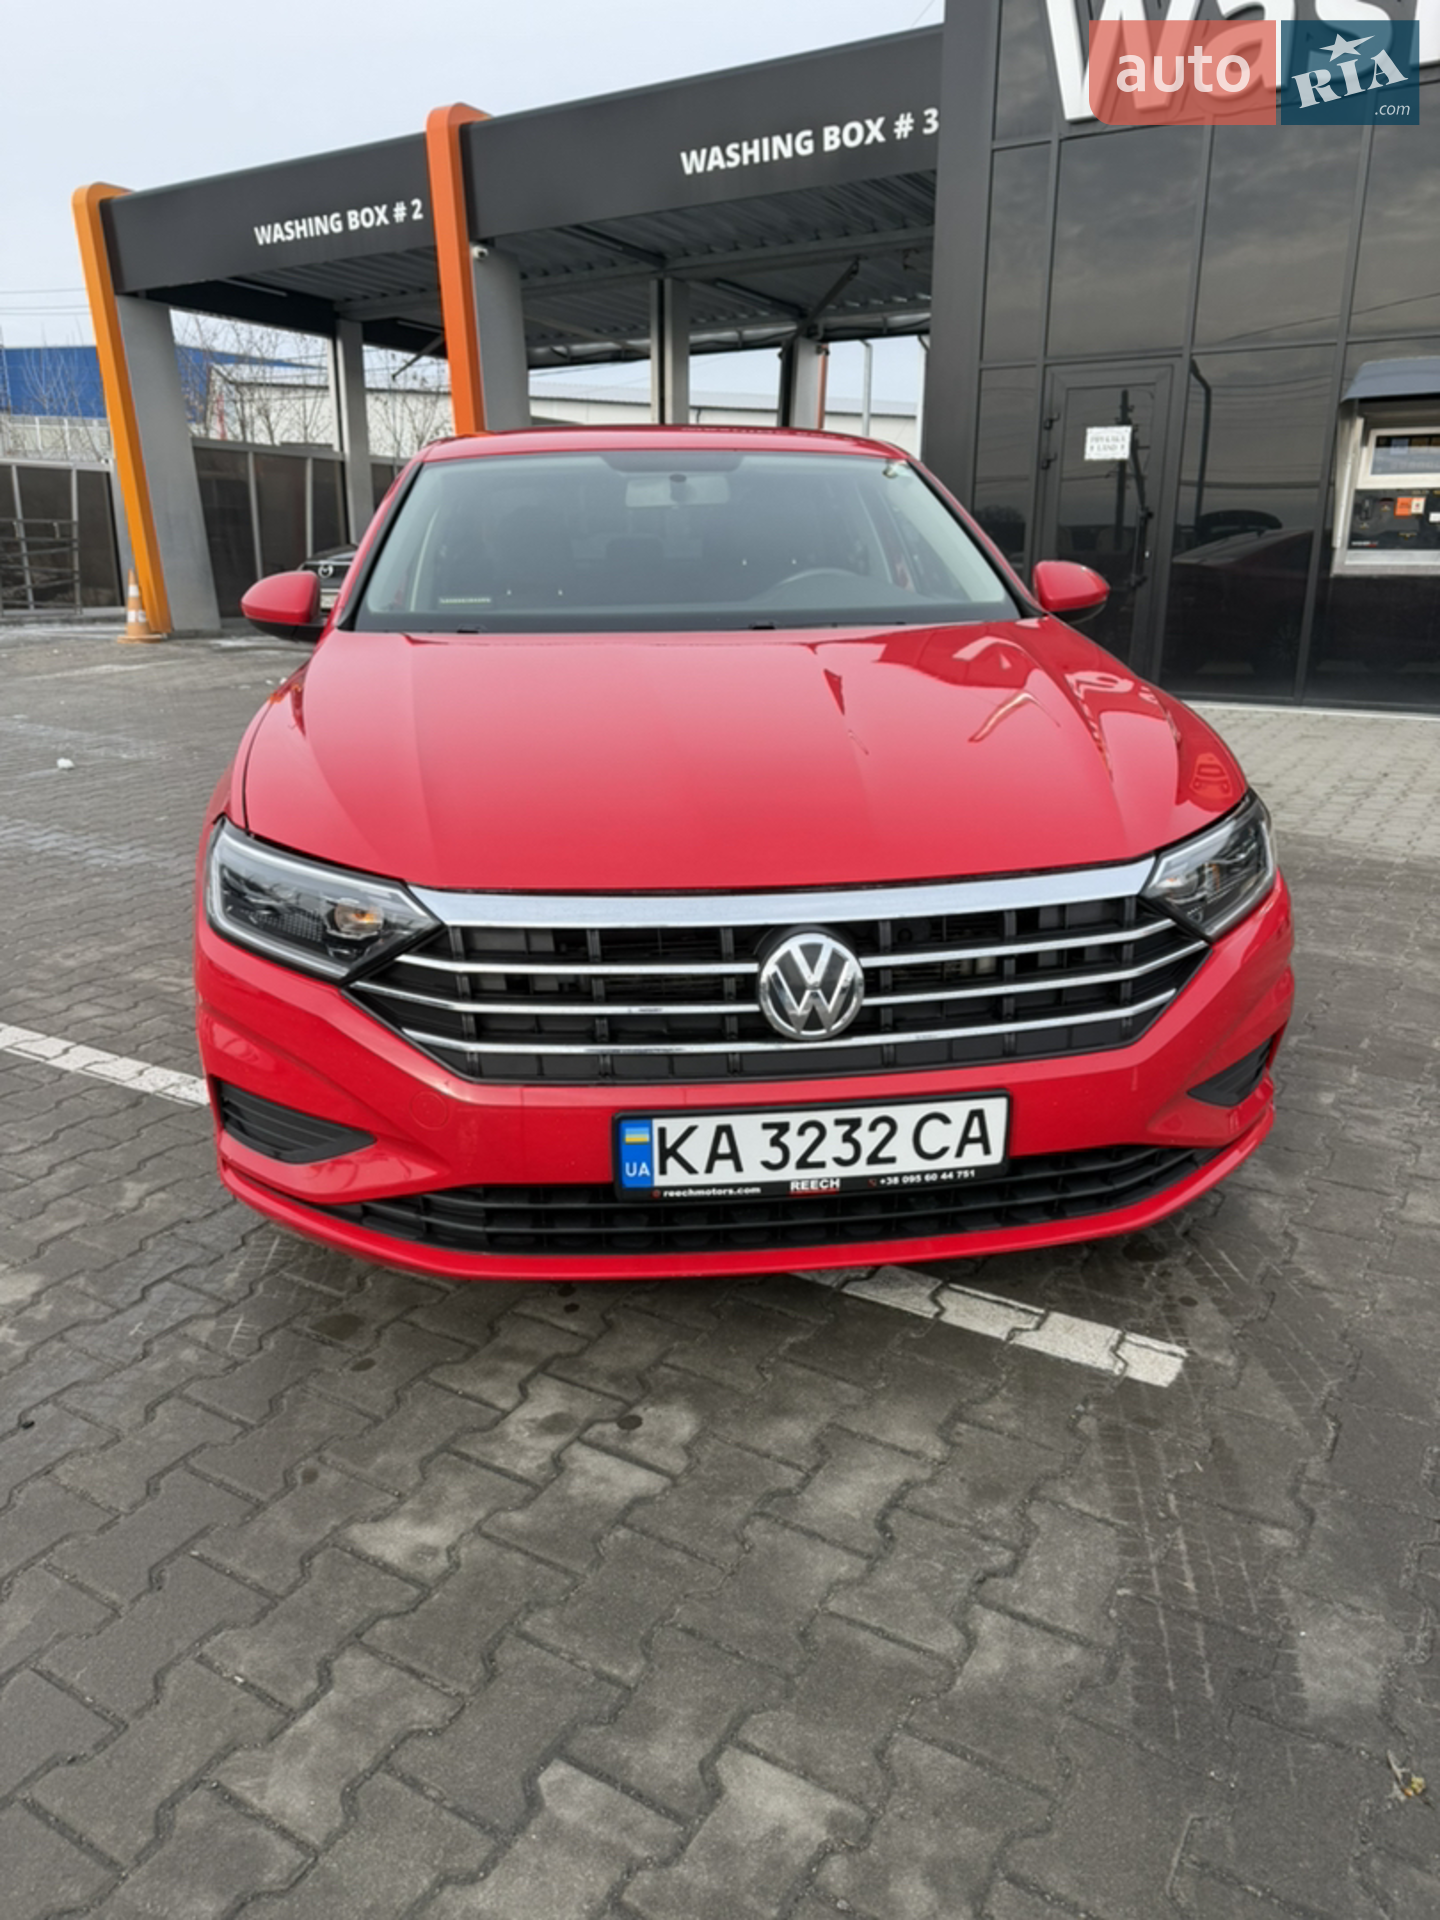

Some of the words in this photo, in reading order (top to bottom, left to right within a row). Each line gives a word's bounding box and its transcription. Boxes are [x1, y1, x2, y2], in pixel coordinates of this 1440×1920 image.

[680, 129, 815, 175] WASHING
[822, 116, 886, 152] BOX
[893, 112, 915, 140] #
[922, 107, 939, 135] 3
[254, 212, 344, 246] WASHING
[347, 204, 390, 231] BOX
[392, 201, 407, 224] #
[411, 198, 424, 221] 2
[656, 1123, 744, 1176] KA
[760, 1115, 898, 1171] 3232
[911, 1108, 992, 1160] CA
[625, 1162, 651, 1177] UA
[789, 1177, 841, 1192] REECH
[879, 1176, 899, 1186] +38
[663, 1186, 762, 1198] reechmotors.com
